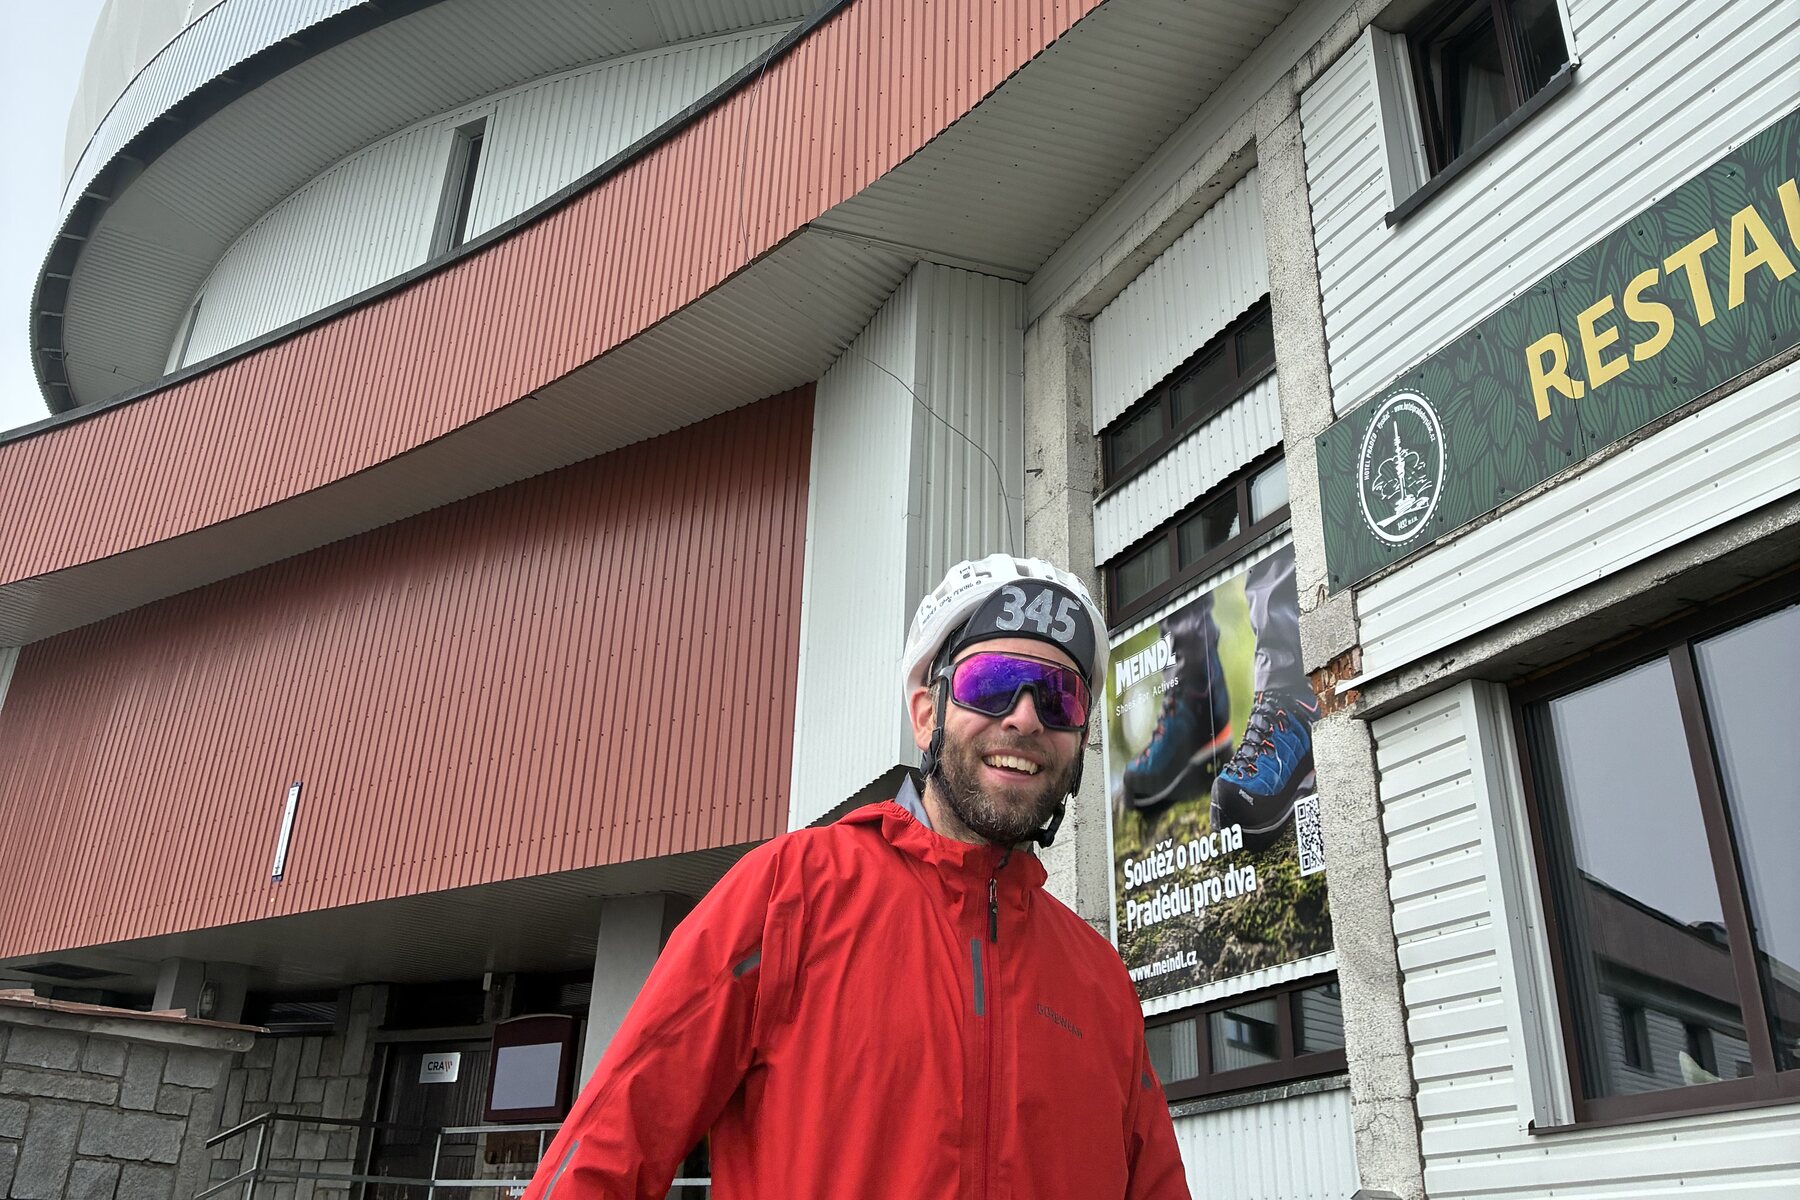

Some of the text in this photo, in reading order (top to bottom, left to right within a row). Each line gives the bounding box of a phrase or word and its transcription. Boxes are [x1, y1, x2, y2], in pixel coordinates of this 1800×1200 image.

[1363, 459, 1371, 481] HOTEL
[995, 585, 1080, 643] 345
[1115, 631, 1177, 698] MEINDL
[1116, 699, 1136, 717] Shoes
[1152, 676, 1179, 697] Actives
[1124, 823, 1243, 890] Soutěž o noc na
[1126, 863, 1257, 932] Pradědu pro dva
[1128, 950, 1198, 982] www.meindl.cz
[427, 1061, 444, 1071] CRA
